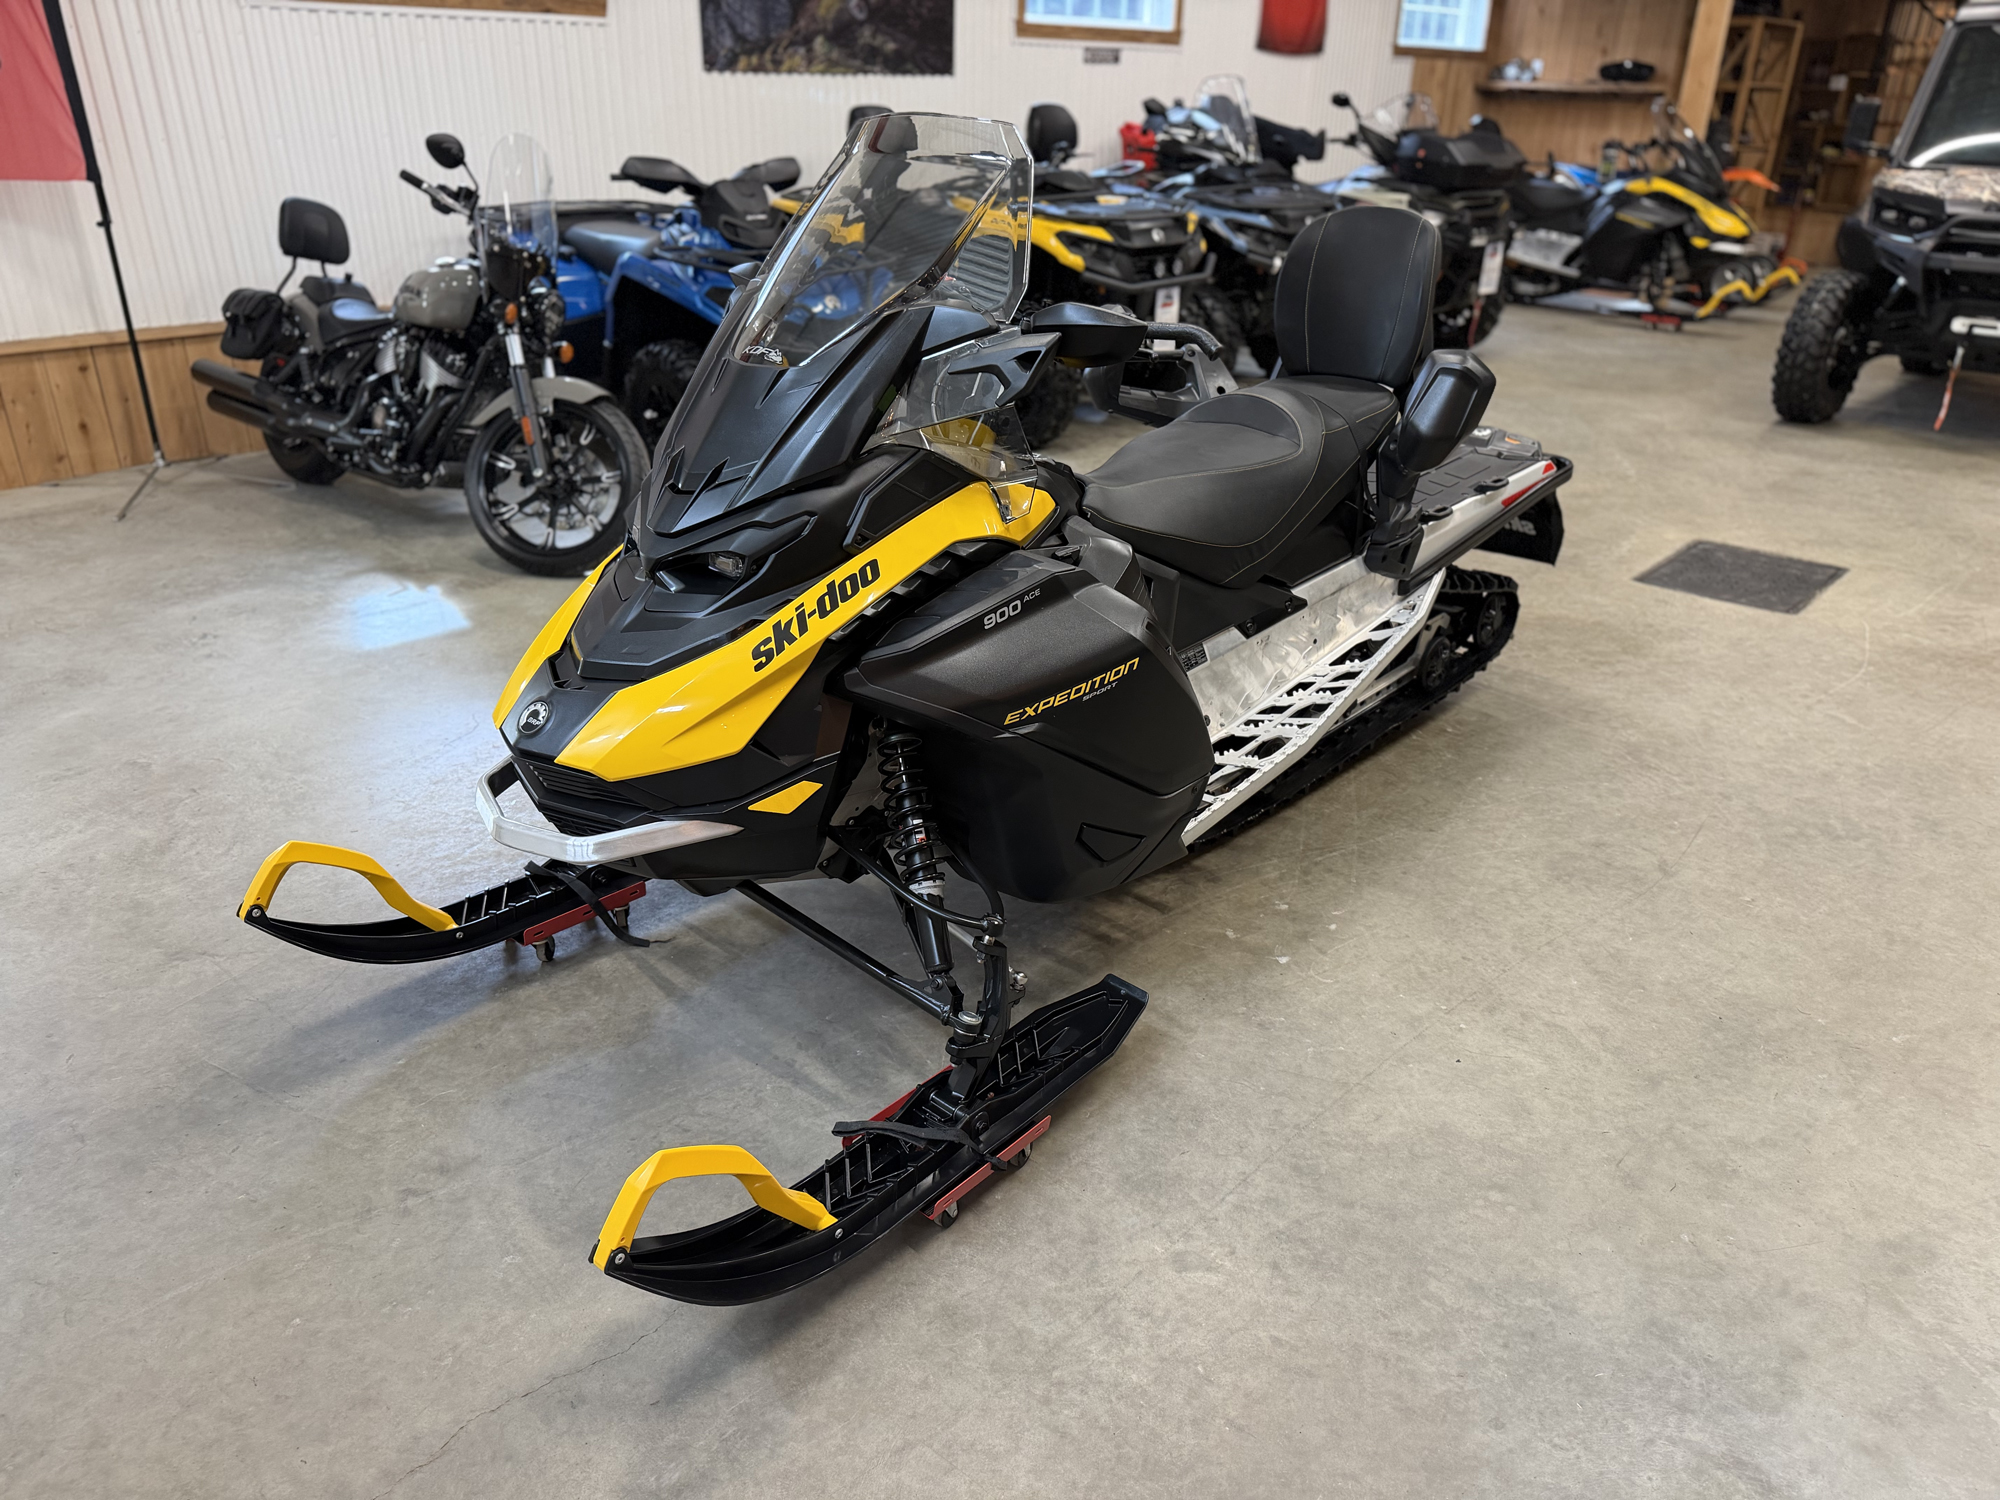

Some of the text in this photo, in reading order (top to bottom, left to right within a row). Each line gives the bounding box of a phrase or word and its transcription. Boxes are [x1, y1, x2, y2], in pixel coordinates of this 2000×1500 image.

[751, 558, 881, 673] ski-doo
[983, 588, 1041, 630] 900 ACE
[1003, 657, 1140, 725] EXPEDITION
[1082, 681, 1118, 702] SPORT
